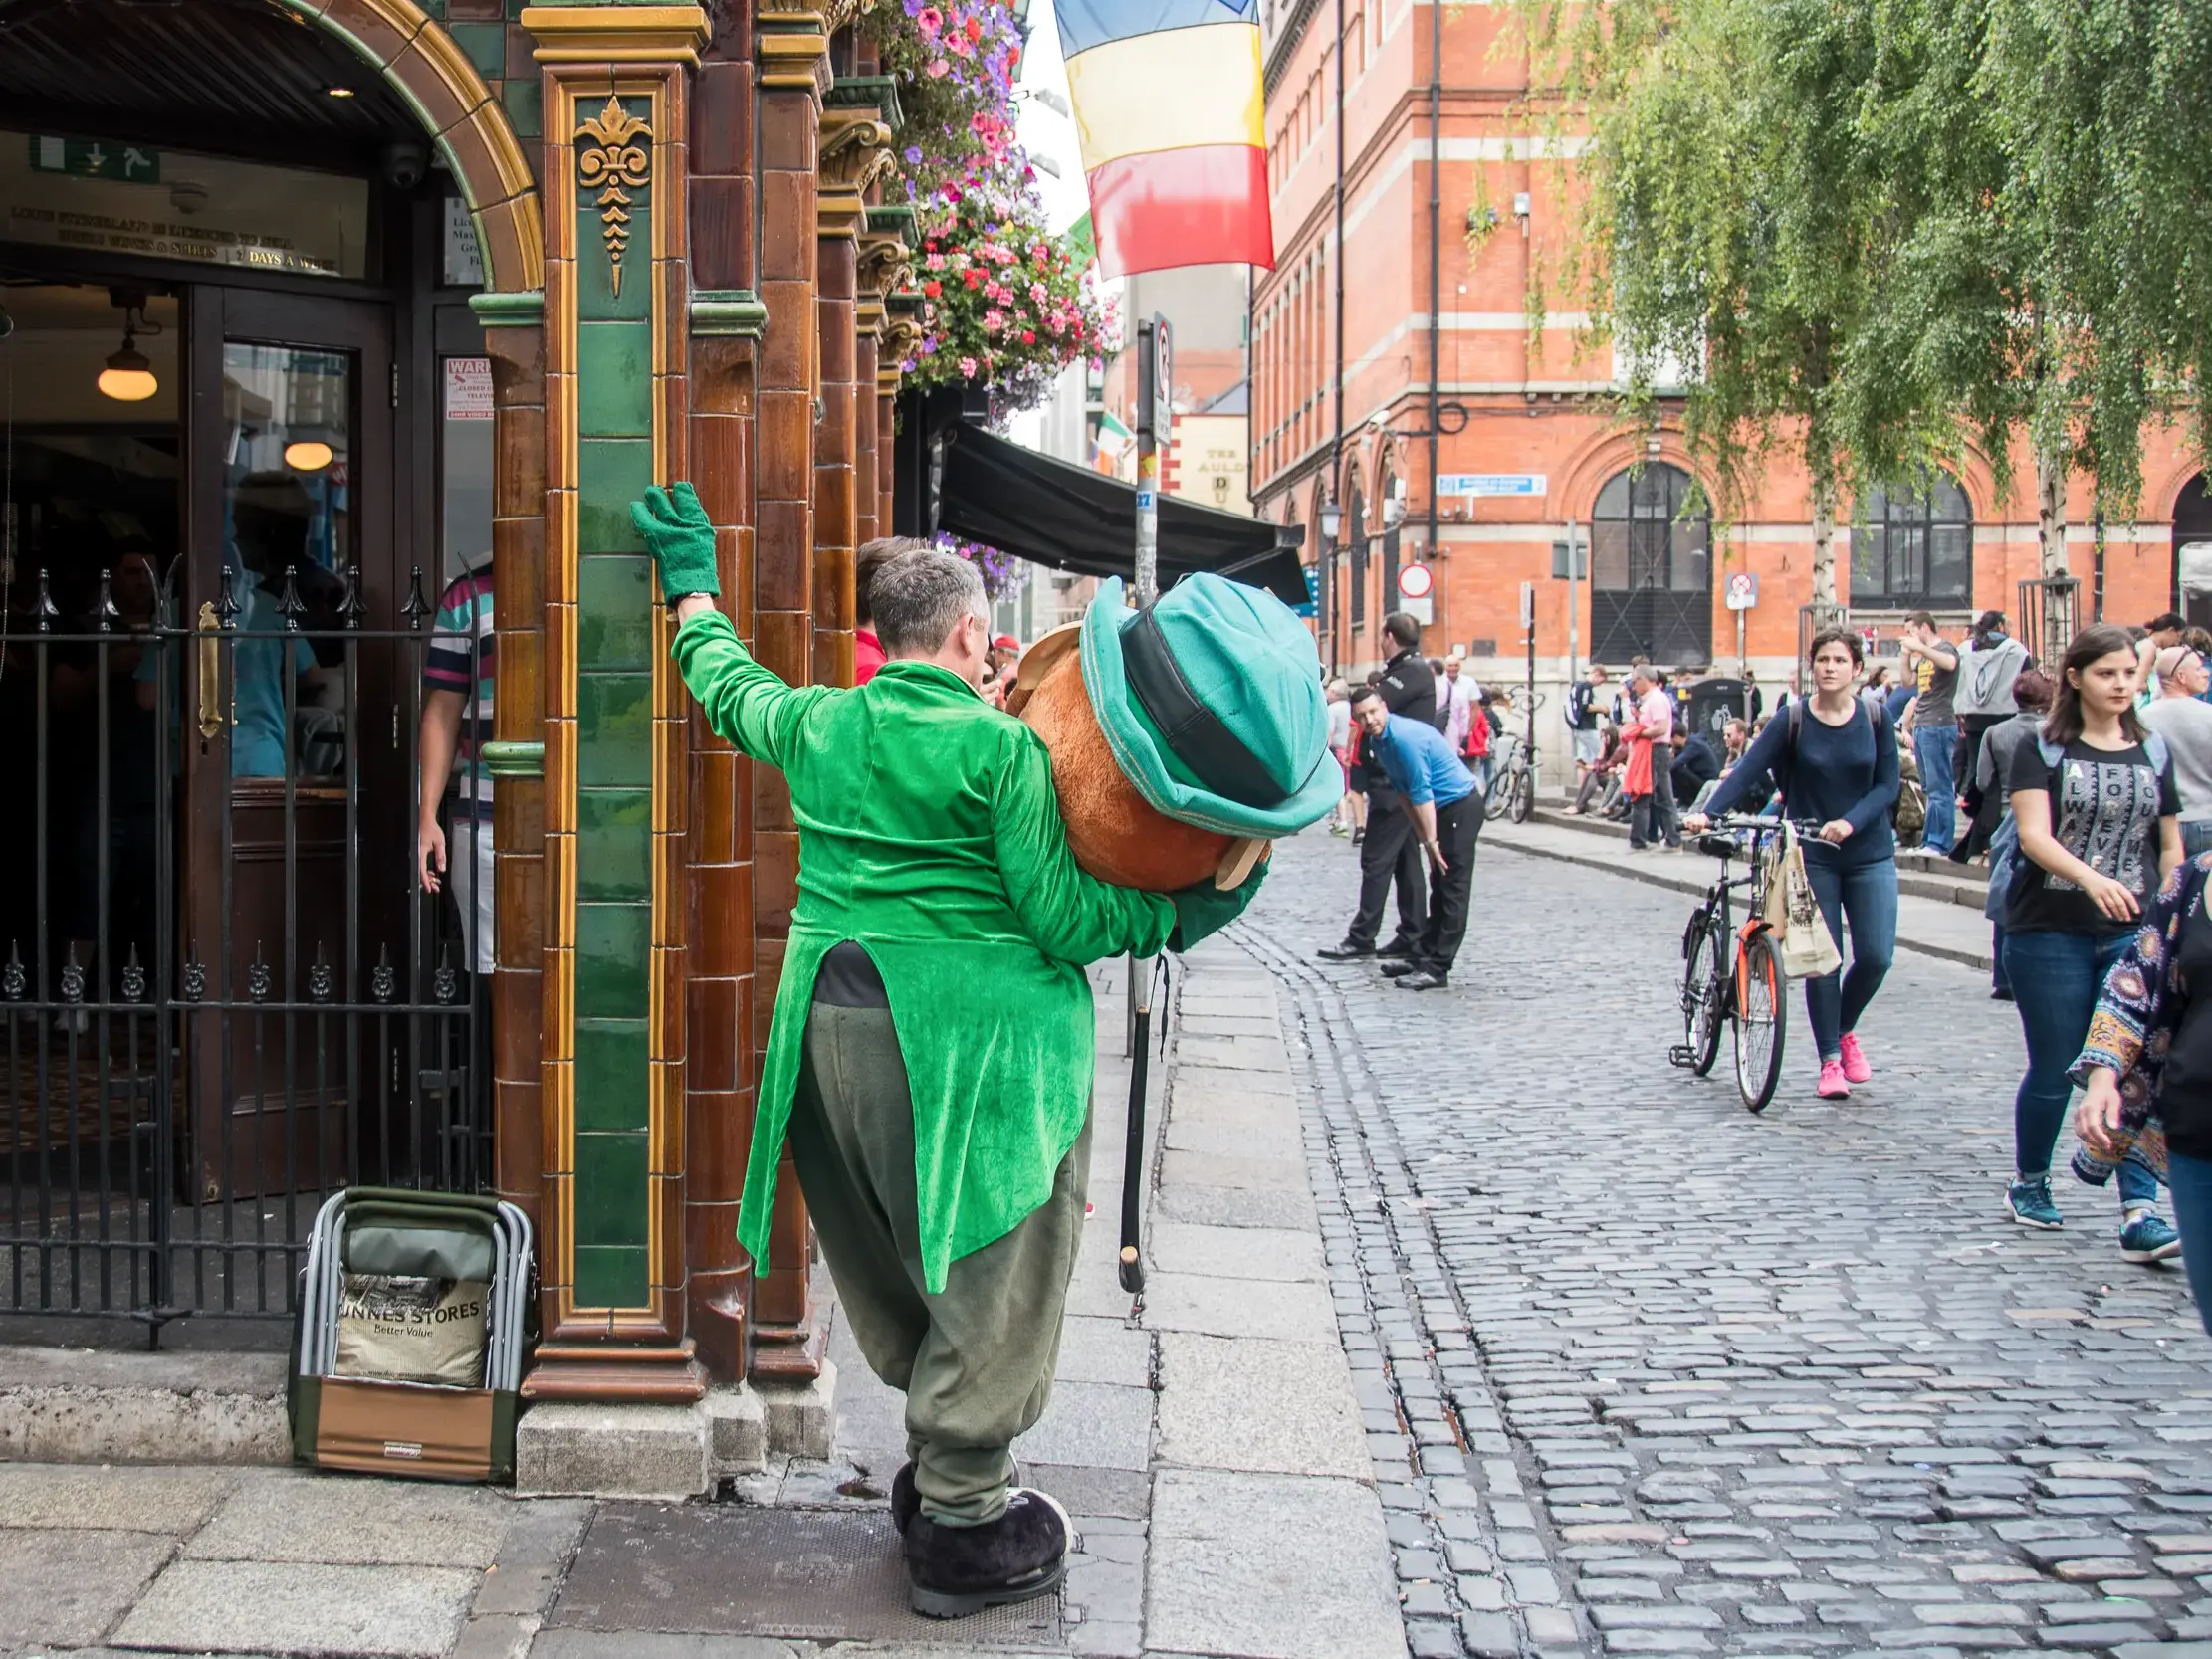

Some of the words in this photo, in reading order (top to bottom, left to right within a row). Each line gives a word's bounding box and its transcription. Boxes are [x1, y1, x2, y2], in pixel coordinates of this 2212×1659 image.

[248, 250, 282, 265] DAYS
[285, 255, 294, 267] A
[1198, 462, 1245, 473] AULD
[411, 1301, 480, 1324] STORES
[374, 1323, 404, 1336] Better
[407, 1326, 434, 1338] Value
